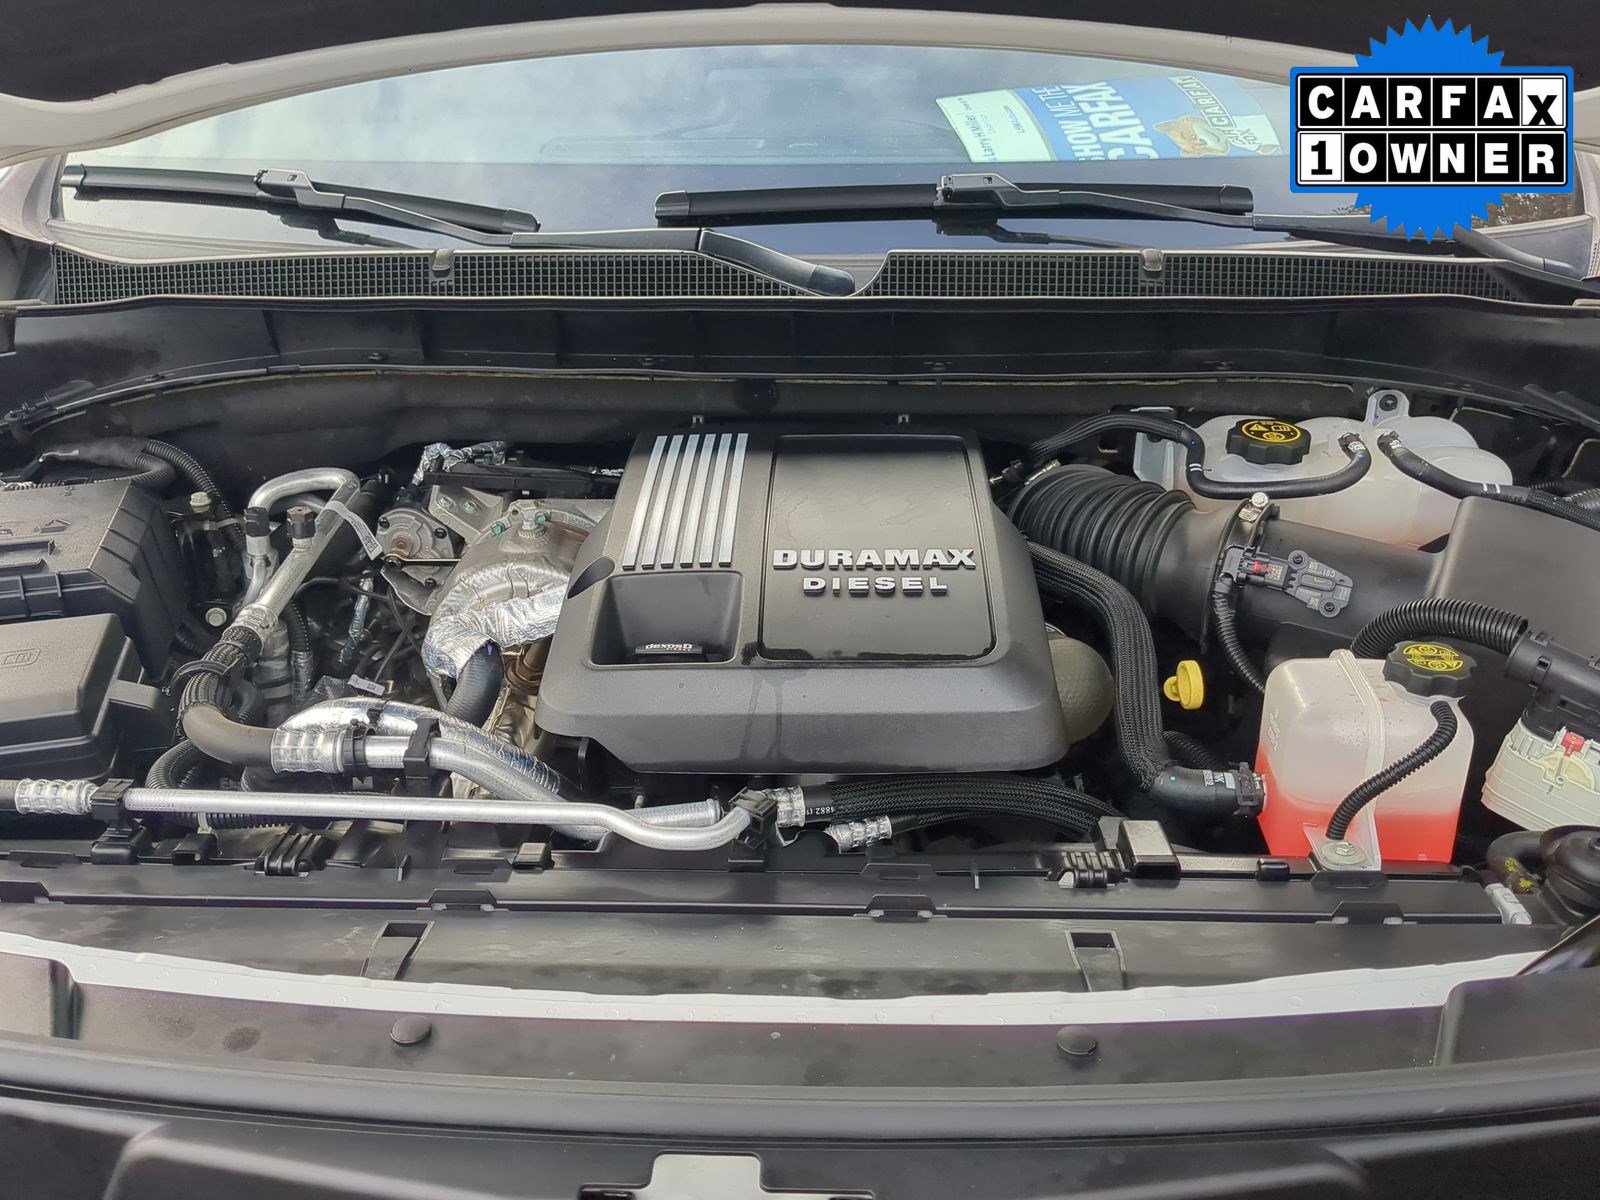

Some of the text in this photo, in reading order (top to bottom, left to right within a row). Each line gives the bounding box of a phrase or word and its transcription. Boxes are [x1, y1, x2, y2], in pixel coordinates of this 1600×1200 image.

[1031, 86, 1069, 102] THE
[1045, 100, 1083, 118] ME
[1060, 81, 1160, 160] CARFAX
[773, 549, 976, 570] DURAMAX
[802, 576, 948, 596] DIESEL
